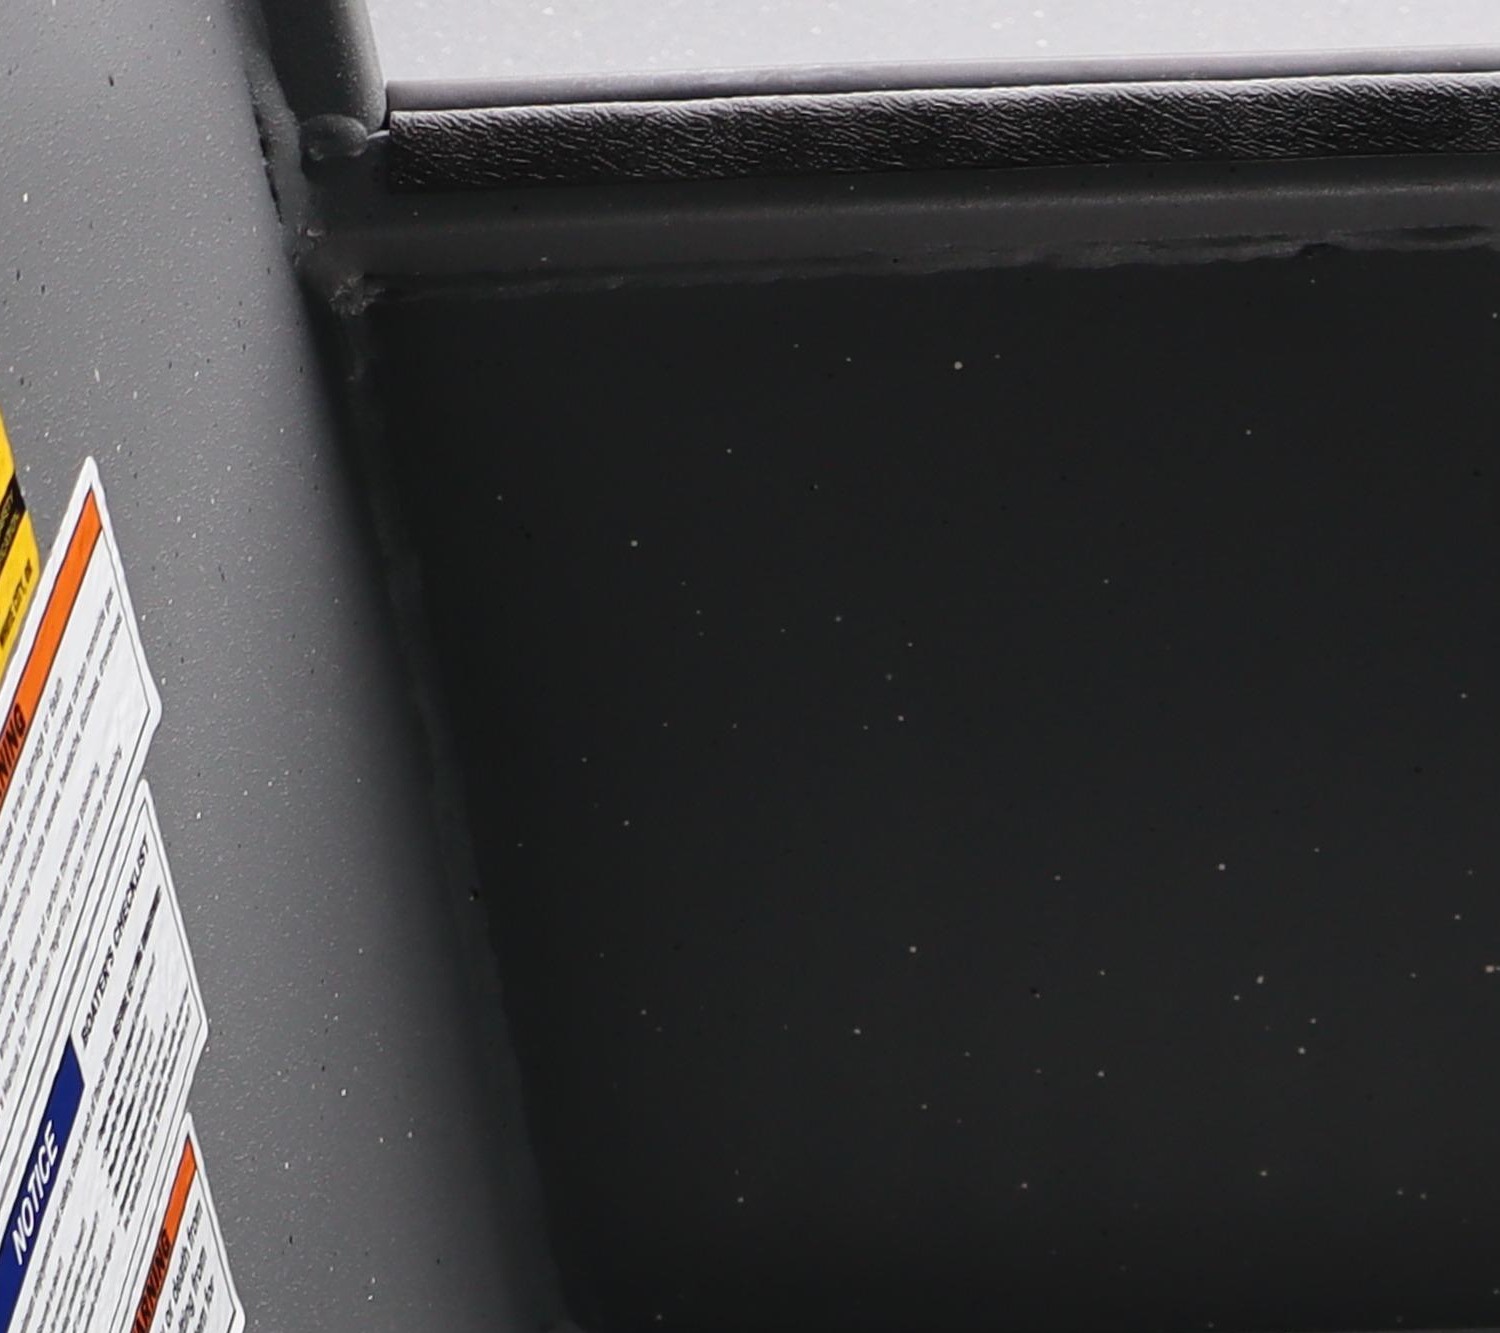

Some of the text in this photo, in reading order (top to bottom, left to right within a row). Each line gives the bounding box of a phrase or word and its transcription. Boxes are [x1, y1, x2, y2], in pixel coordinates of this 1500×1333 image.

[80, 941, 114, 1053] BOATER'S
[112, 832, 149, 952] CHECKLIST
[11, 1115, 59, 1269] NOTICE
[164, 1299, 174, 1331] or
[171, 1240, 189, 1305] death
[187, 1196, 202, 1250] from
[191, 1241, 206, 1296] from
[203, 1269, 215, 1310] for
